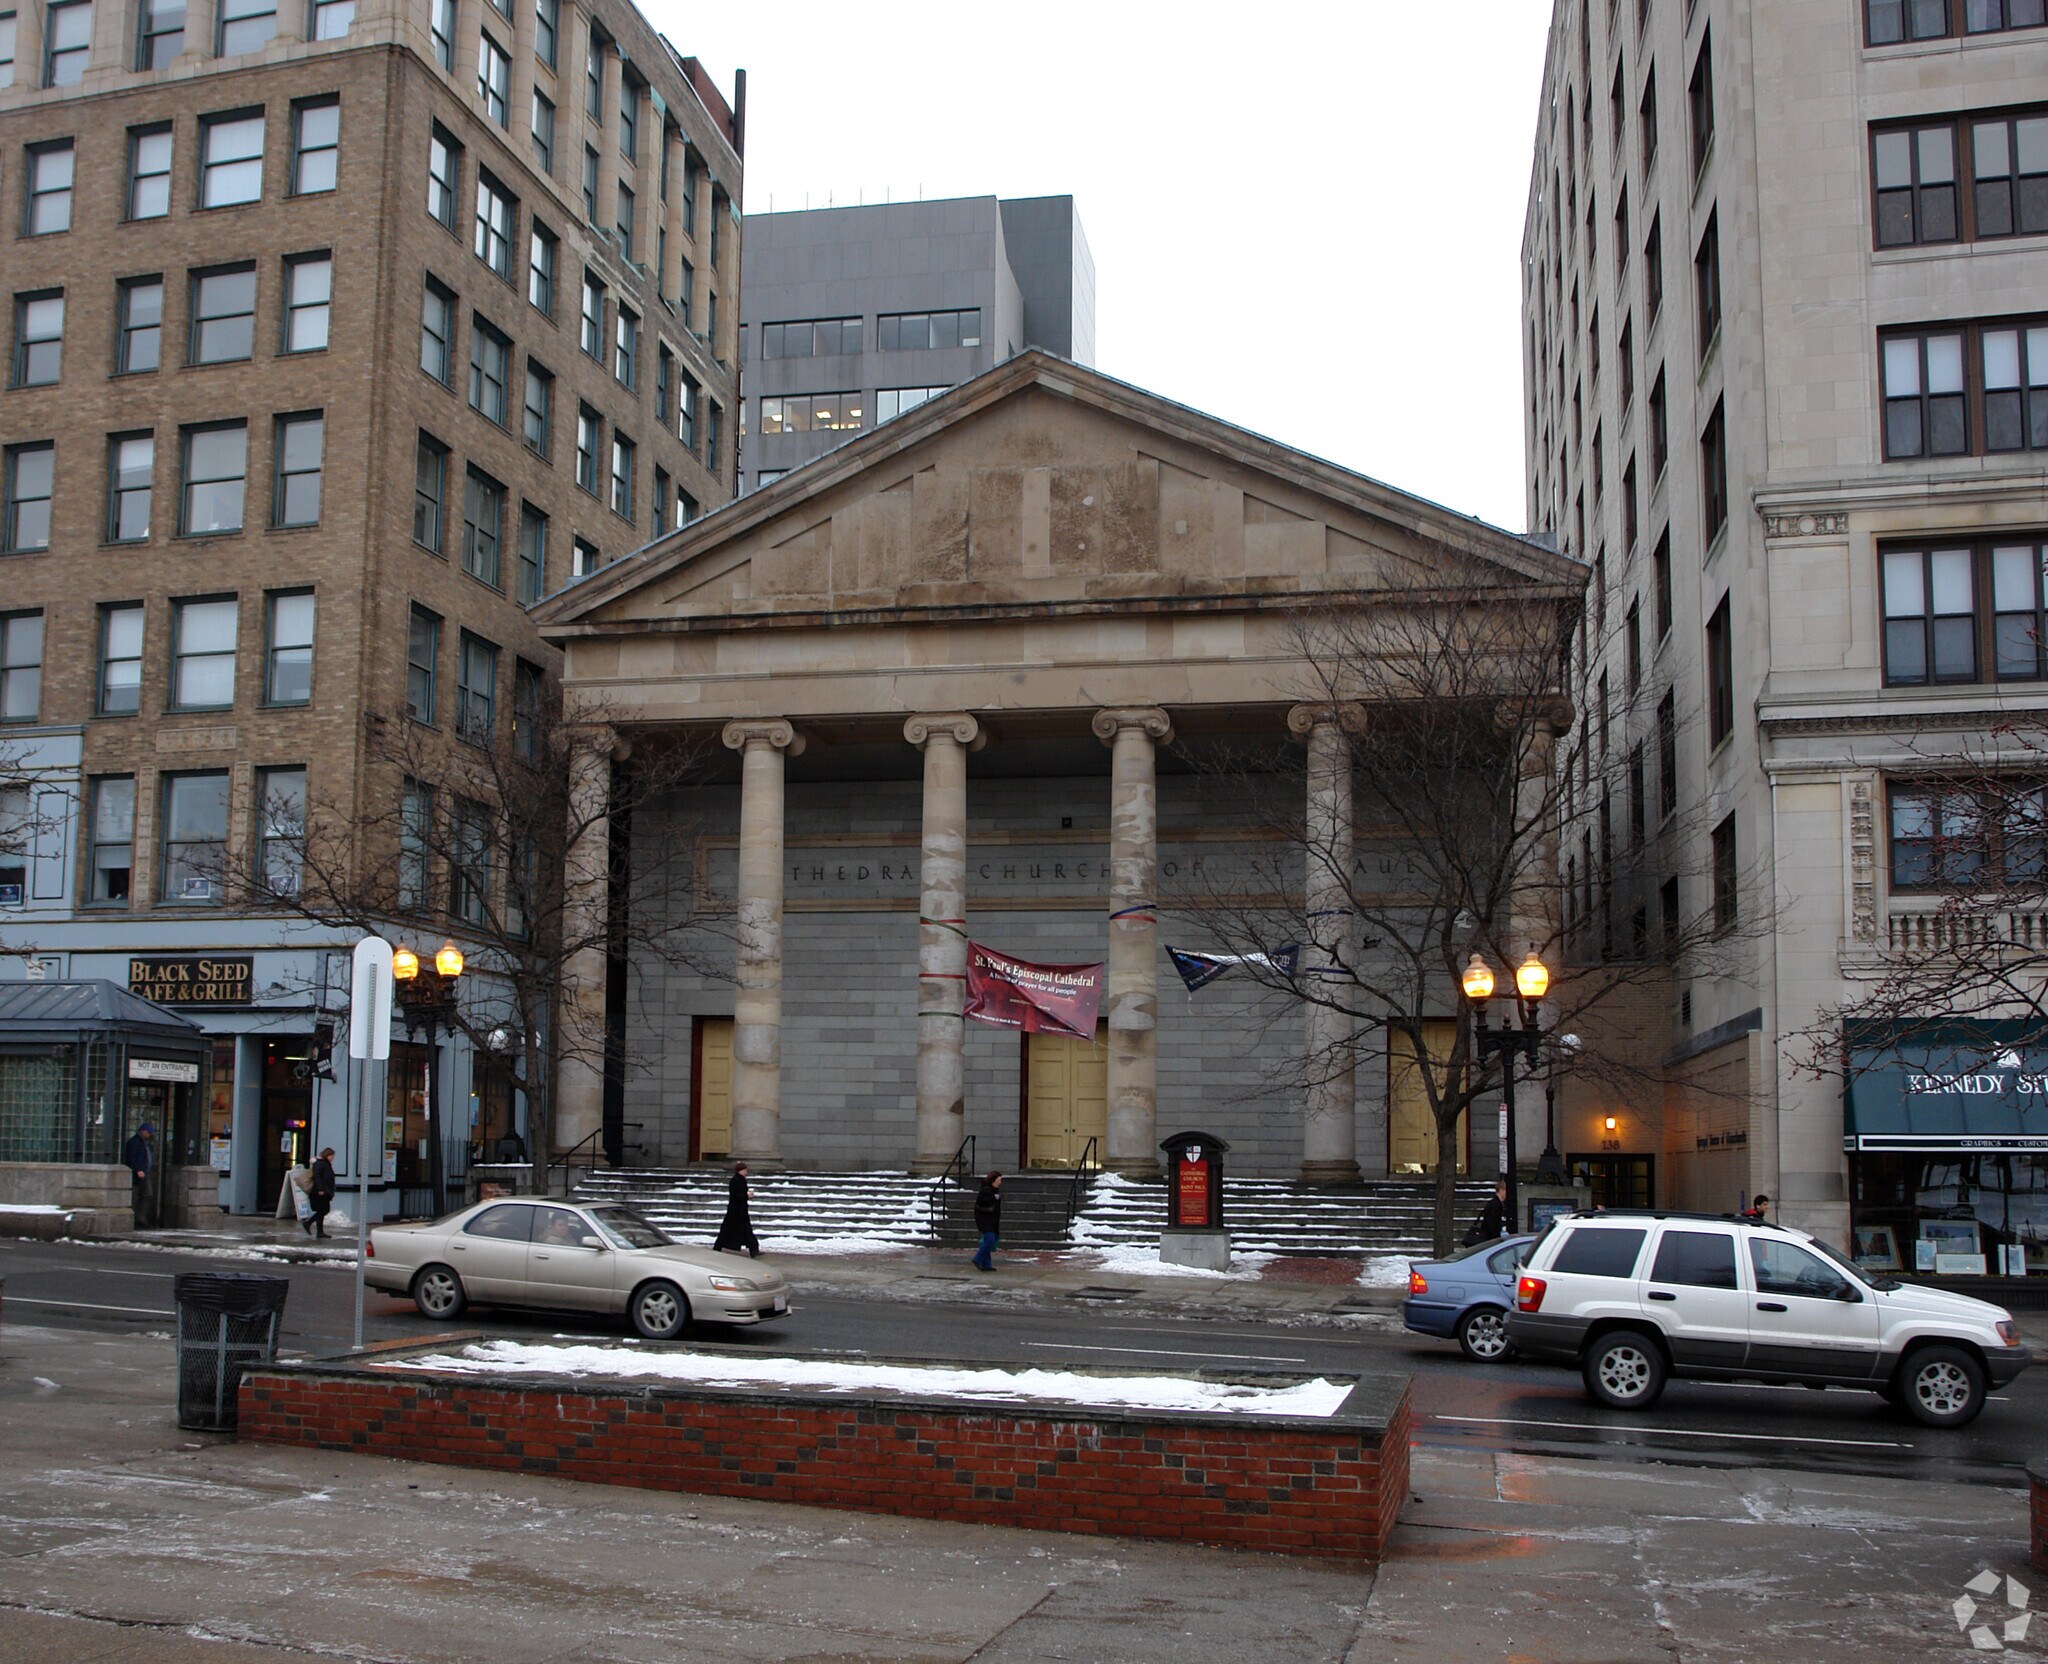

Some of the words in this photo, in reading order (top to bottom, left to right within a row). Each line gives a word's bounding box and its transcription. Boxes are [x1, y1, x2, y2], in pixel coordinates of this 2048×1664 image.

[1163, 861, 1202, 877] OF
[1353, 858, 1416, 875] AUL
[129, 961, 190, 982] BLACK
[198, 960, 249, 981] SEED
[974, 954, 986, 967] St.
[987, 957, 1011, 974] Paul's
[1012, 964, 1053, 983] Episcopal
[1054, 972, 1095, 987] Cathedral
[1018, 979, 1038, 990] prayer
[1037, 983, 1048, 991] for
[1047, 985, 1056, 993] all
[1055, 987, 1077, 997] people
[137, 1061, 150, 1070] NOT
[151, 1062, 160, 1071] AN
[160, 1063, 191, 1073] ENTRANCE
[1907, 1074, 2005, 1095] KENNEDY
[1601, 1139, 1620, 1150] 138
[1960, 1139, 2002, 1148] GRAPHICS
